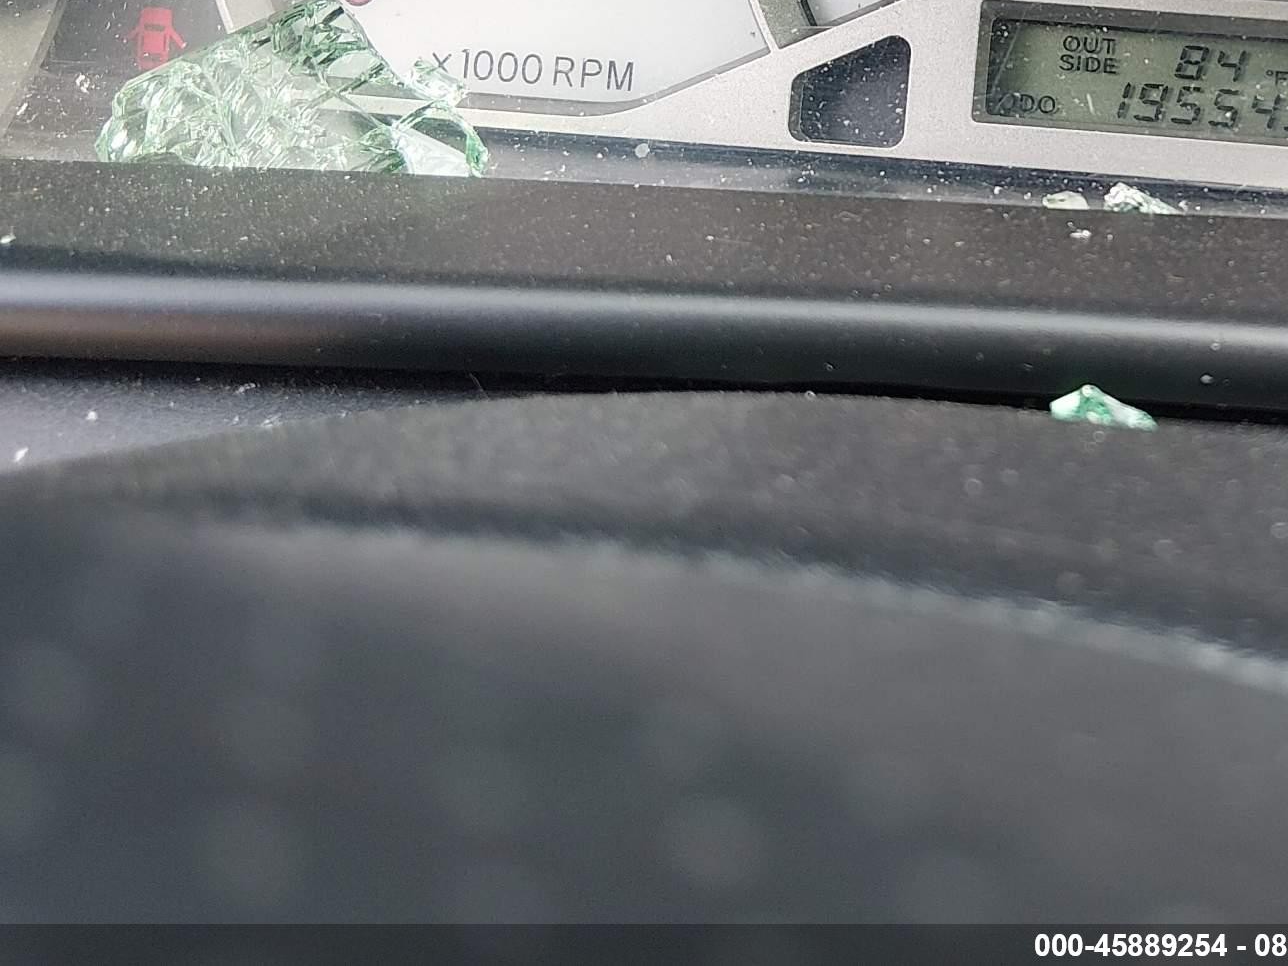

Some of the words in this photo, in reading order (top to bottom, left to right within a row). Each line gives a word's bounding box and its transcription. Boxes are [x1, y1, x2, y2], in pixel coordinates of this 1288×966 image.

[1063, 35, 1117, 55] OUT
[553, 56, 634, 92] RPM
[1059, 54, 1118, 75] SIDE
[1174, 45, 1247, 82] 84
